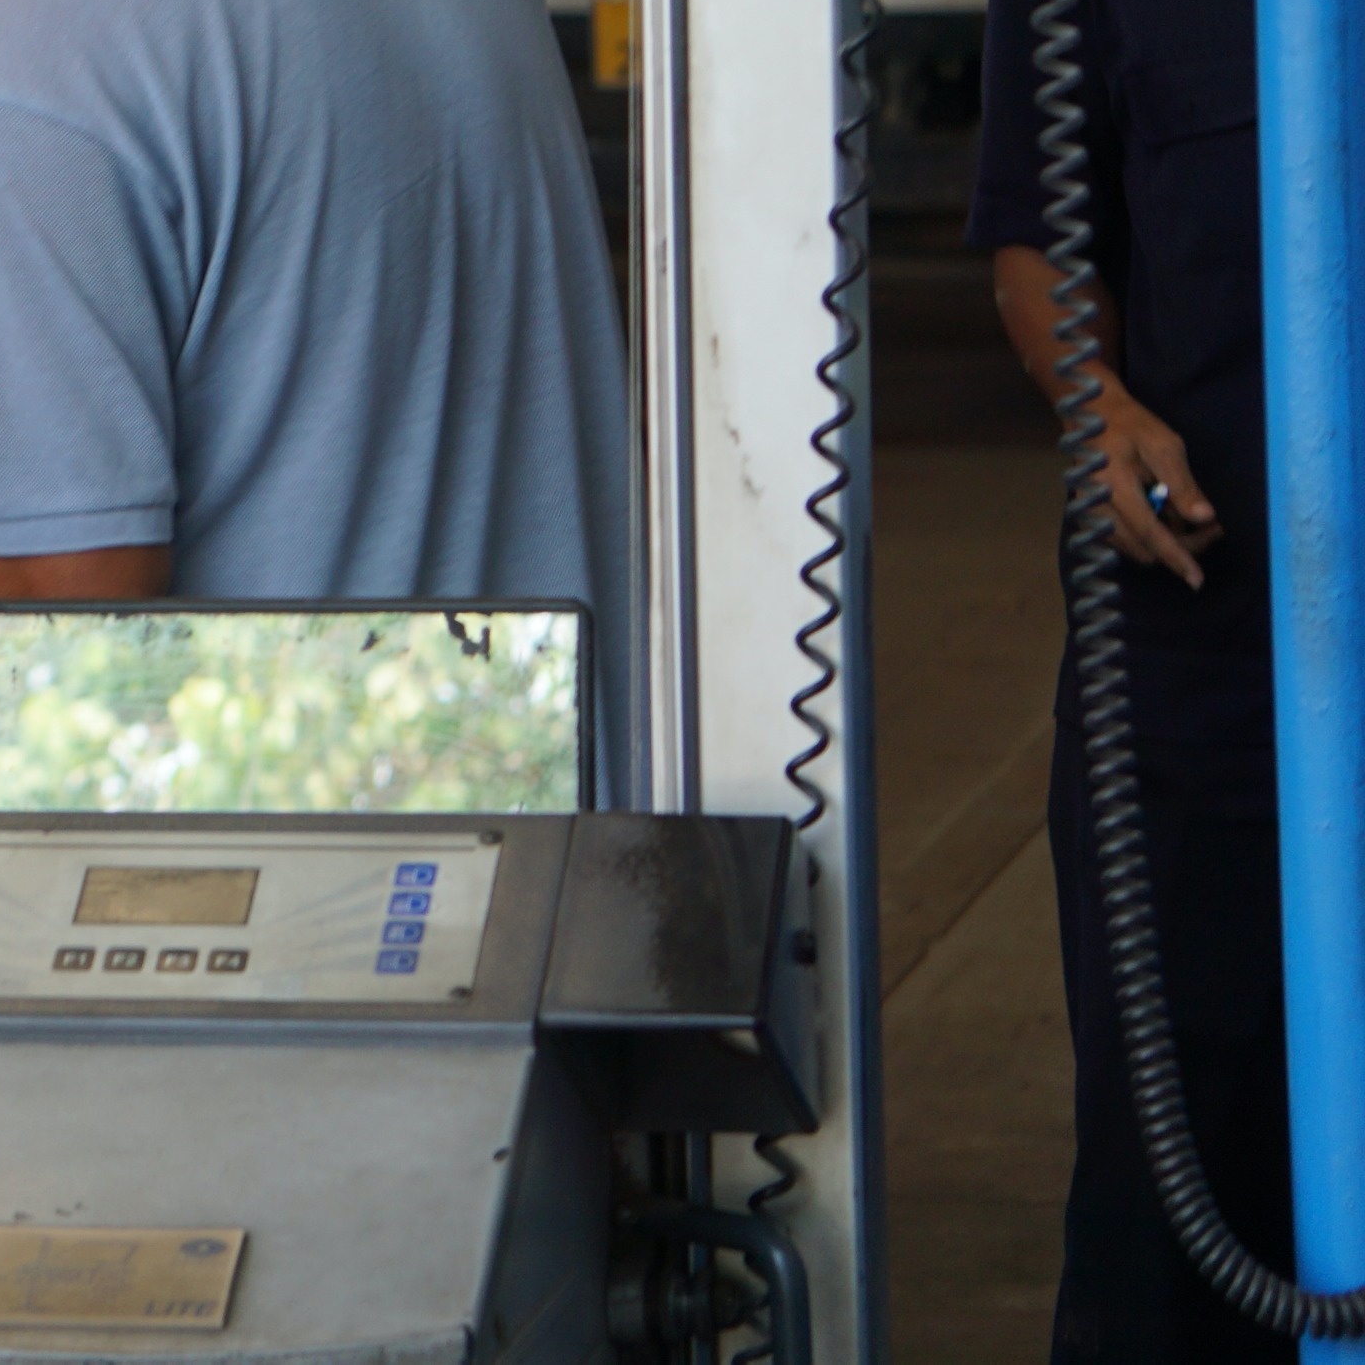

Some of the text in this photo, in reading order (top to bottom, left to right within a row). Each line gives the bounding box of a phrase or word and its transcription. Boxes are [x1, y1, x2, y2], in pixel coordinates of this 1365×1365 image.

[62, 952, 88, 966] F1
[111, 952, 138, 966] F2
[213, 952, 242, 966] F4
[144, 1299, 218, 1318] LITE
